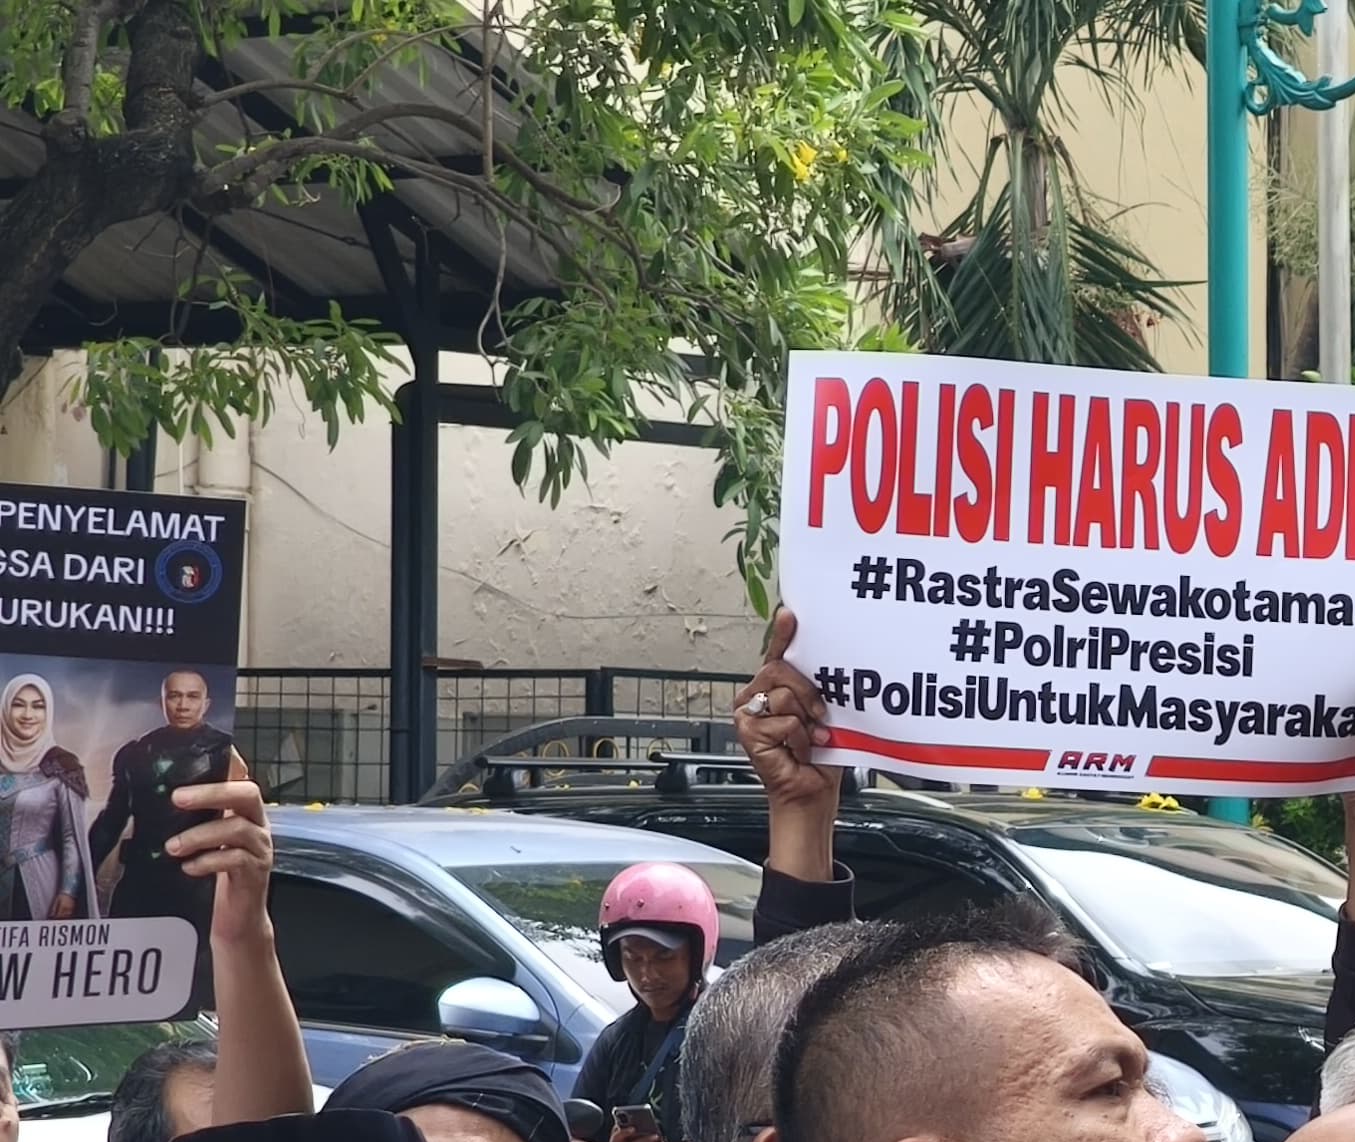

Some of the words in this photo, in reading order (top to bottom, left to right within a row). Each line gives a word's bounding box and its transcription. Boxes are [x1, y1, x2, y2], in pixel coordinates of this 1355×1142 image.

[807, 376, 1017, 544] POLISI
[1027, 391, 1243, 558] HARUS
[63, 553, 145, 585] DARI
[850, 555, 1355, 627] #RastraSewakotama
[949, 617, 1255, 678] #PolriPresisi
[1057, 751, 1137, 773] ARM
[39, 923, 110, 947] RISMON
[52, 948, 162, 999] HERO
